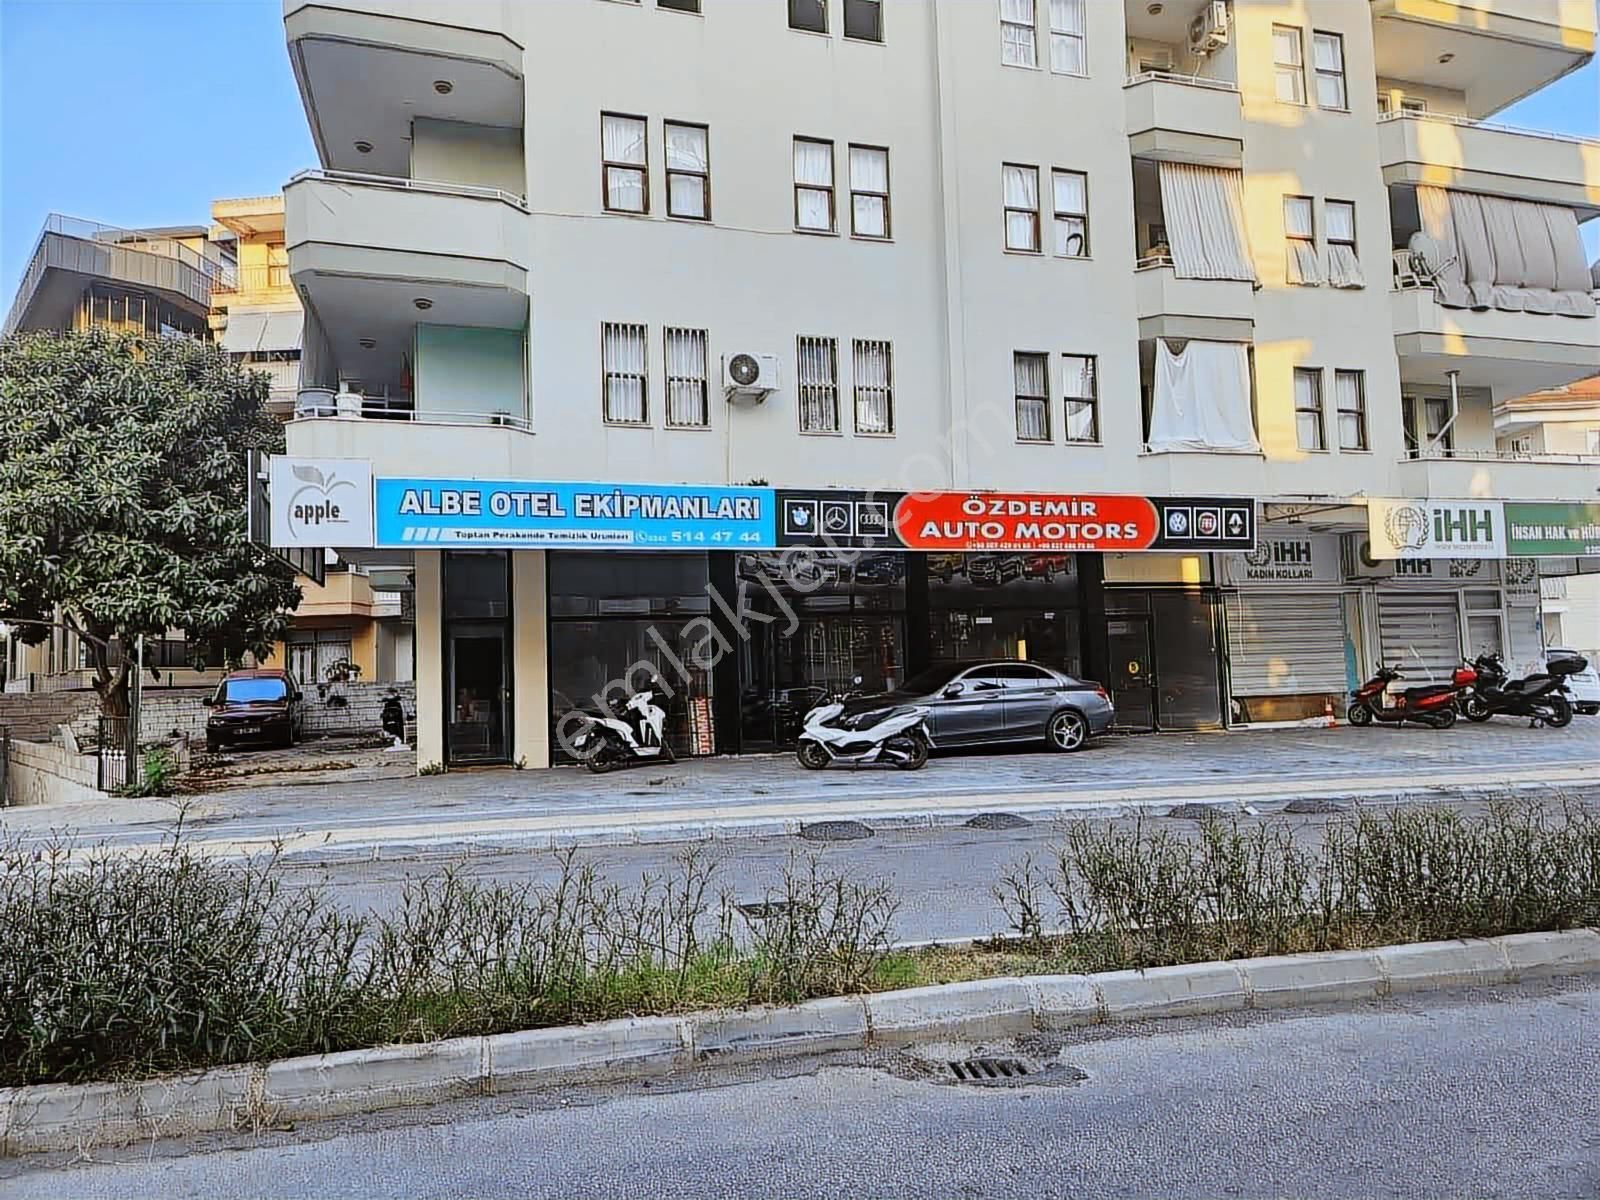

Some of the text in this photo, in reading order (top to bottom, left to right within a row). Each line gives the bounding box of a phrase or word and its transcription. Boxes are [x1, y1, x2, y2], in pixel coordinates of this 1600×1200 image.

[294, 499, 340, 525] apple
[399, 488, 760, 520] ALBE OTEL EKİPMANLARI
[962, 494, 1098, 517] ÖZDEMİR
[671, 530, 705, 542] 514
[710, 530, 733, 542] 47
[739, 531, 761, 543] 44
[919, 521, 1139, 540] AUTO MOTORS
[1544, 524, 1567, 541] HAK
[1247, 569, 1313, 579] KADIN KOLLARI
